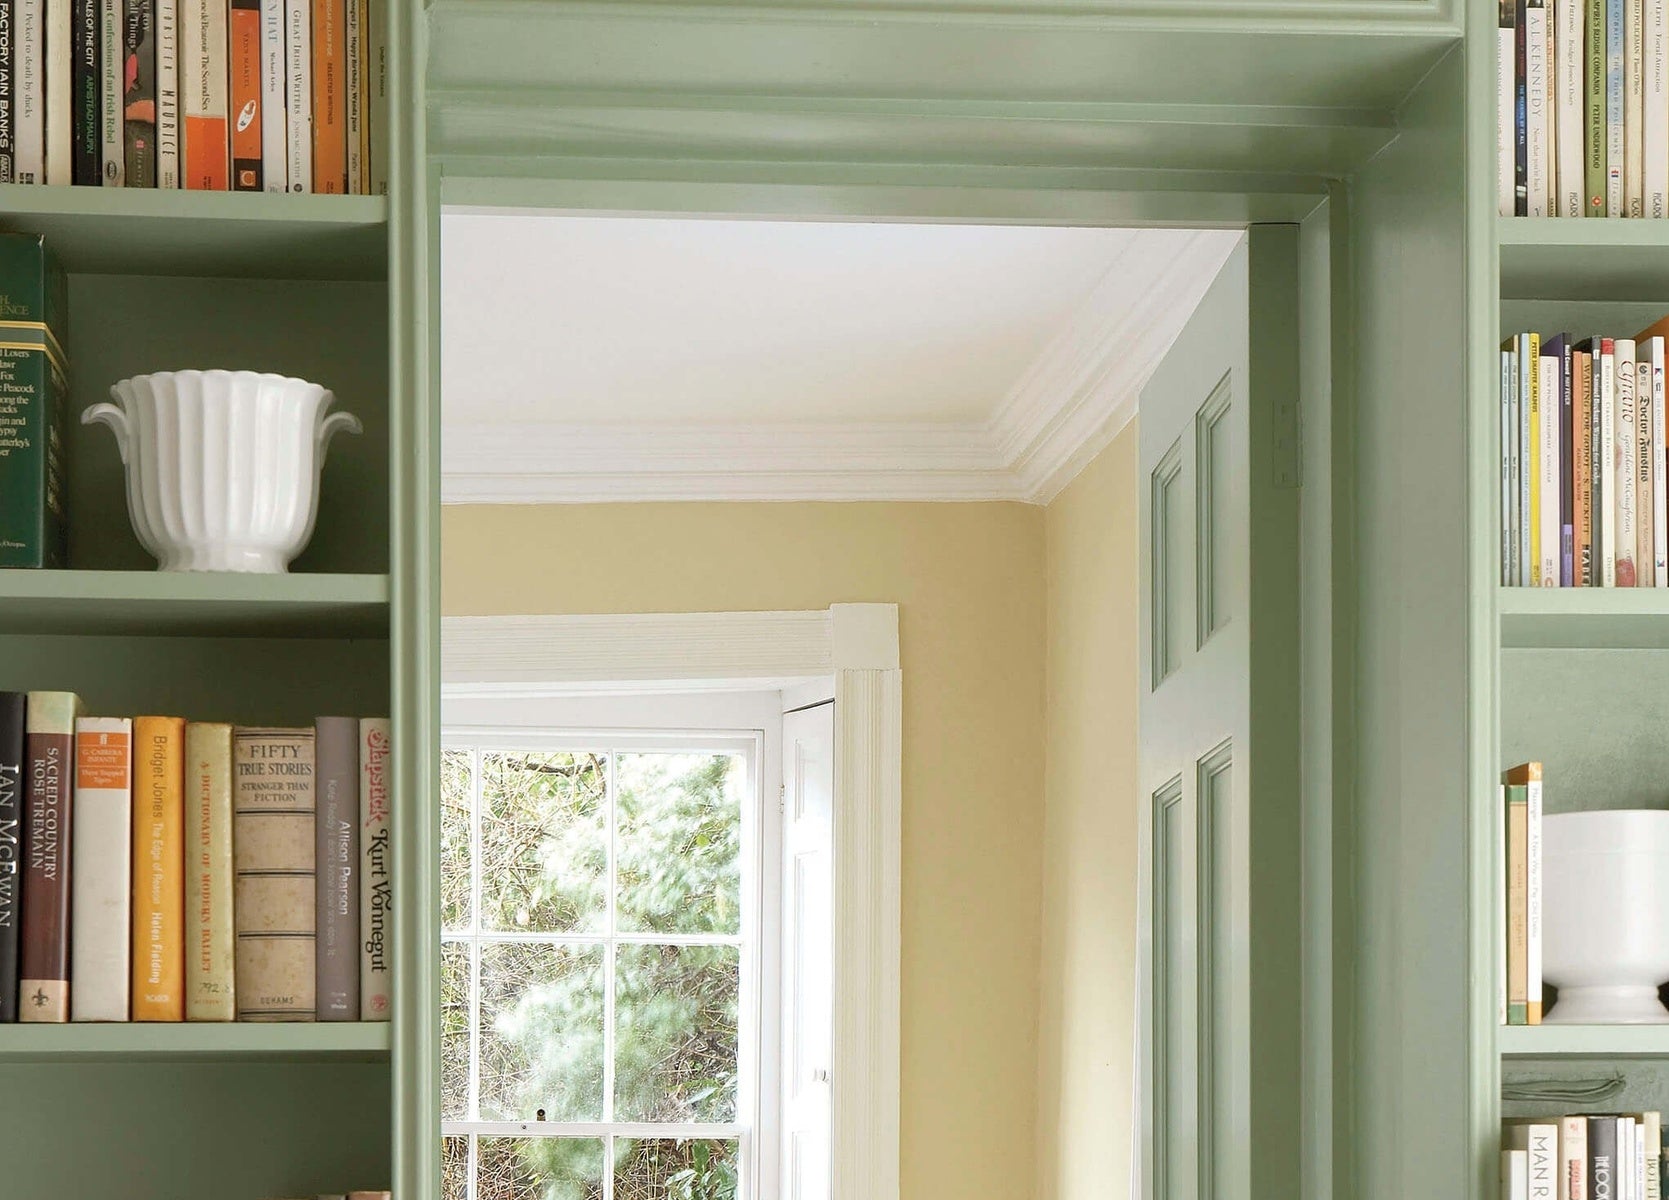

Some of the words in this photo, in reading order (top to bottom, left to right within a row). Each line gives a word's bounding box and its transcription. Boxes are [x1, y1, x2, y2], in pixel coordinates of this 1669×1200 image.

[0, 3, 9, 66] FACTORY
[25, 13, 33, 42] Pecked
[85, 19, 94, 29] OF
[128, 16, 139, 48] Things
[163, 6, 173, 70] FORSTER
[293, 10, 302, 40] GREAT
[25, 45, 33, 53] to
[85, 31, 94, 47] THE
[106, 13, 115, 67] Confessions
[350, 36, 358, 58] Happy
[25, 56, 33, 79] death
[85, 49, 94, 67] CITY
[201, 55, 210, 69] The
[269, 52, 277, 75] Michael
[293, 45, 303, 70] IRISH
[0, 69, 9, 96] IAIN
[23, 81, 32, 91] by
[106, 69, 115, 78] of
[106, 79, 114, 91] an
[200, 70, 210, 96] Second
[24, 94, 33, 118] ducks
[86, 75, 94, 121] ARMISTEAD
[106, 94, 115, 115] Irish
[202, 97, 210, 111] Sex
[293, 73, 303, 115] WRITERS
[0, 100, 9, 148] BANKS
[106, 117, 115, 144] Rebel
[162, 89, 175, 156] MAURICE
[350, 116, 358, 132] June
[4, 383, 35, 393] Peacock
[1616, 360, 1635, 425] Cyrano
[1639, 395, 1650, 436] Doctor
[150, 735, 168, 778] Bridget
[200, 761, 210, 769] A
[250, 745, 302, 758] FIFTY
[33, 759, 46, 795] ROSE
[46, 747, 60, 805] SACRED
[237, 762, 265, 776] TRUE
[268, 762, 312, 776] STORIES
[364, 728, 390, 827] Slapstick
[0, 763, 19, 808] IAN
[152, 782, 167, 818] Jones
[241, 782, 284, 791] STRANGER
[286, 782, 309, 791] THAN
[254, 793, 297, 802] FICTION
[201, 775, 211, 846] DICTIONARY
[32, 799, 45, 869] TREMAIN
[44, 808, 58, 881] COUNTRY
[152, 822, 164, 838] The
[338, 820, 351, 862] Allison
[150, 840, 164, 861] Edge
[201, 853, 211, 868] OF
[366, 828, 389, 877] Kurt
[152, 862, 164, 872] of
[152, 873, 164, 904] Reason
[201, 873, 211, 923] MODERN
[338, 866, 351, 915] Pearson
[151, 912, 163, 941] Helen
[365, 880, 391, 973] Vonnegut
[149, 944, 163, 984] Fielding
[201, 929, 211, 974] BALLET
[1532, 1136, 1549, 1180] MAN
[1595, 1167, 1610, 1200] LOOK
